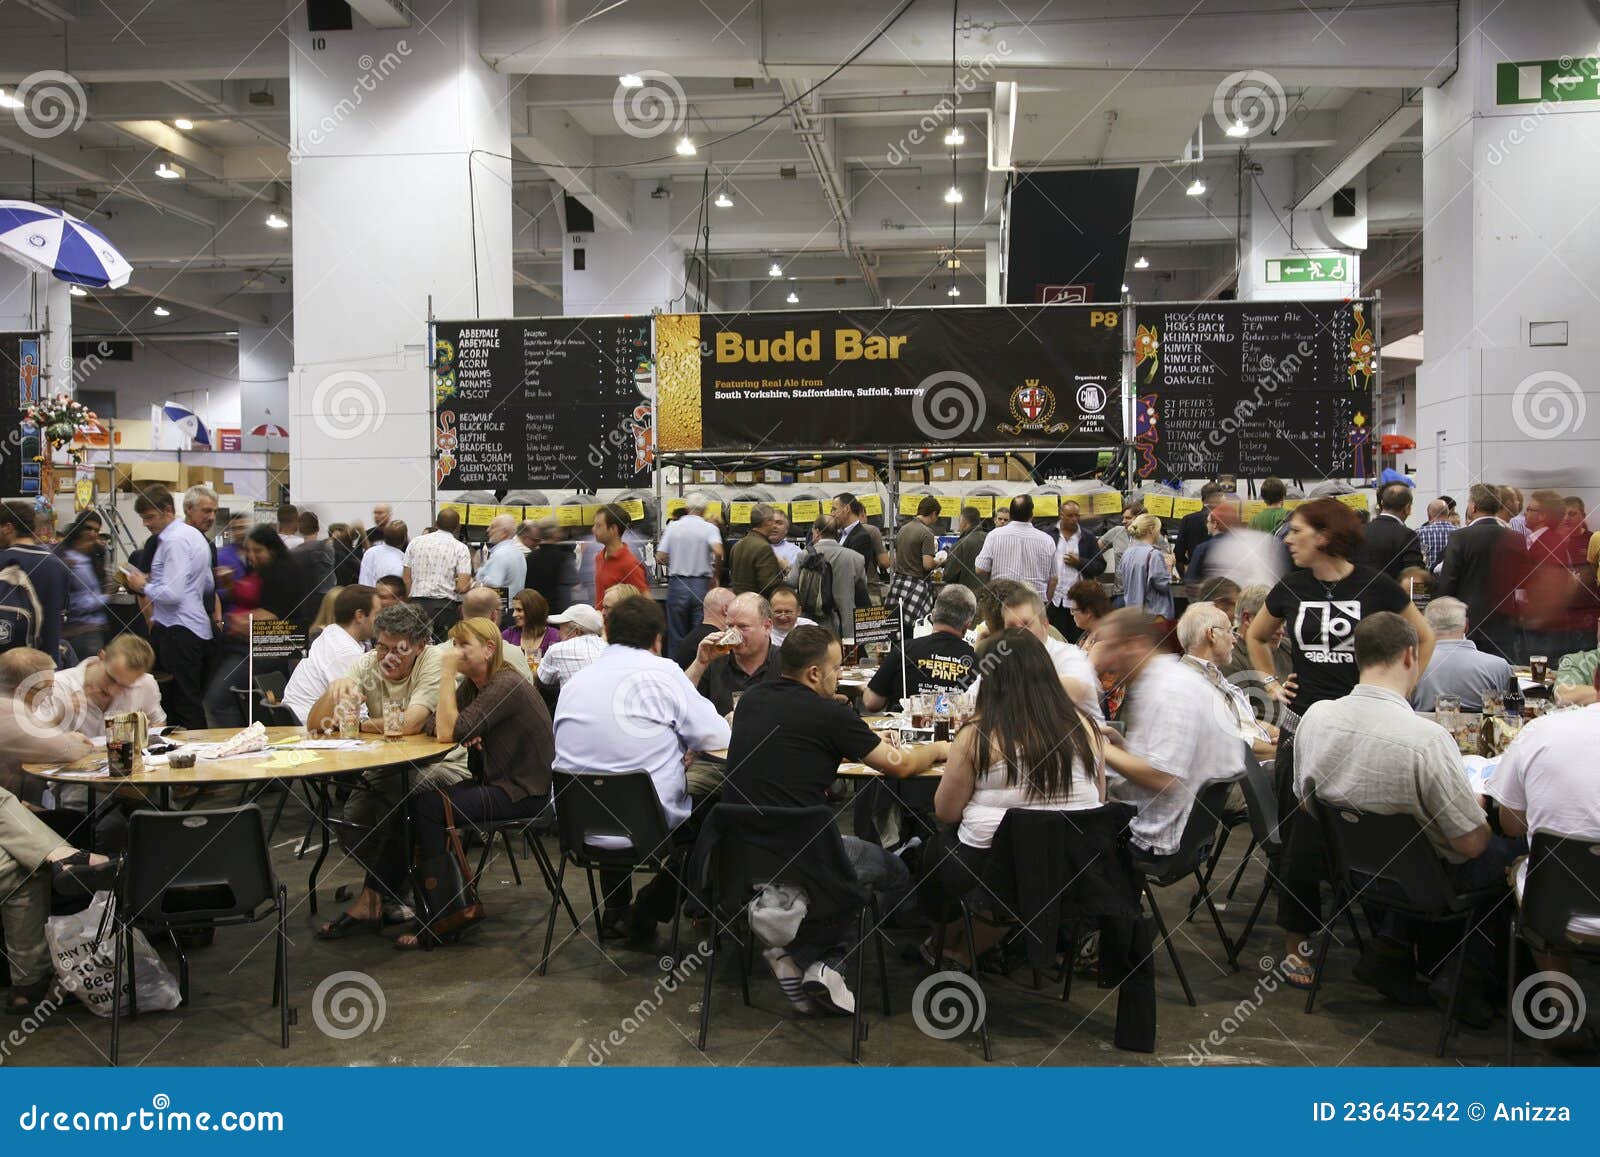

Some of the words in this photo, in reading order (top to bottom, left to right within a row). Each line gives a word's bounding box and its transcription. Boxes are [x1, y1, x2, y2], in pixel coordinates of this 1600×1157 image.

[312, 38, 326, 50] 10
[1090, 311, 1119, 328] P8
[1165, 313, 1196, 321] HOGS
[1197, 312, 1225, 321] BACK
[1242, 312, 1280, 321] Summer
[1165, 322, 1196, 331] HOGS
[1197, 322, 1225, 332] BACK
[1242, 322, 1263, 331] TEA
[459, 328, 499, 338] ABBEYDALE
[1164, 332, 1199, 342] KELHAM
[1200, 332, 1235, 342] ISLAND
[459, 339, 501, 348] ABBEYDALE
[715, 329, 821, 363] Budd
[835, 328, 907, 361] Bar
[1165, 343, 1202, 353] KINVER
[459, 349, 489, 358] ACORN
[1164, 353, 1202, 363] KINVER
[459, 359, 488, 368] ACORN
[459, 369, 492, 378] ADNAMS
[459, 379, 492, 388] ADNAMS
[715, 379, 760, 389] Featuring
[762, 379, 782, 388] Real
[784, 378, 799, 387] Ale
[801, 378, 824, 387] from
[1164, 375, 1215, 385] OAKWELL
[460, 389, 490, 399] ASCOT
[714, 389, 742, 399] South
[743, 388, 791, 399] Yorkshire,
[792, 387, 855, 398] Staffordshire,
[856, 386, 893, 397] Suffolk,
[894, 387, 925, 397] Surrey
[1165, 400, 1177, 409] ST
[460, 412, 493, 422] BEOWULF
[1164, 408, 1176, 418] ST
[460, 422, 481, 431] BLACK
[484, 422, 505, 431] HOLE
[1164, 420, 1198, 429] SURREY
[460, 433, 487, 442] BLYTHE
[1166, 430, 1203, 440] TITANIC
[460, 443, 503, 452] BRADFIELD
[460, 453, 478, 462] EARL
[480, 453, 513, 463] SOHAM
[460, 463, 514, 473] GLENTWORTH
[460, 473, 484, 483] GREEN
[487, 473, 508, 482] JACK
[934, 654, 951, 662] found
[1304, 651, 1354, 663] elektra
[917, 659, 970, 674] PERFECT
[931, 669, 959, 681] PINT
[57, 947, 80, 960] BUY
[88, 983, 130, 1004] Guie
